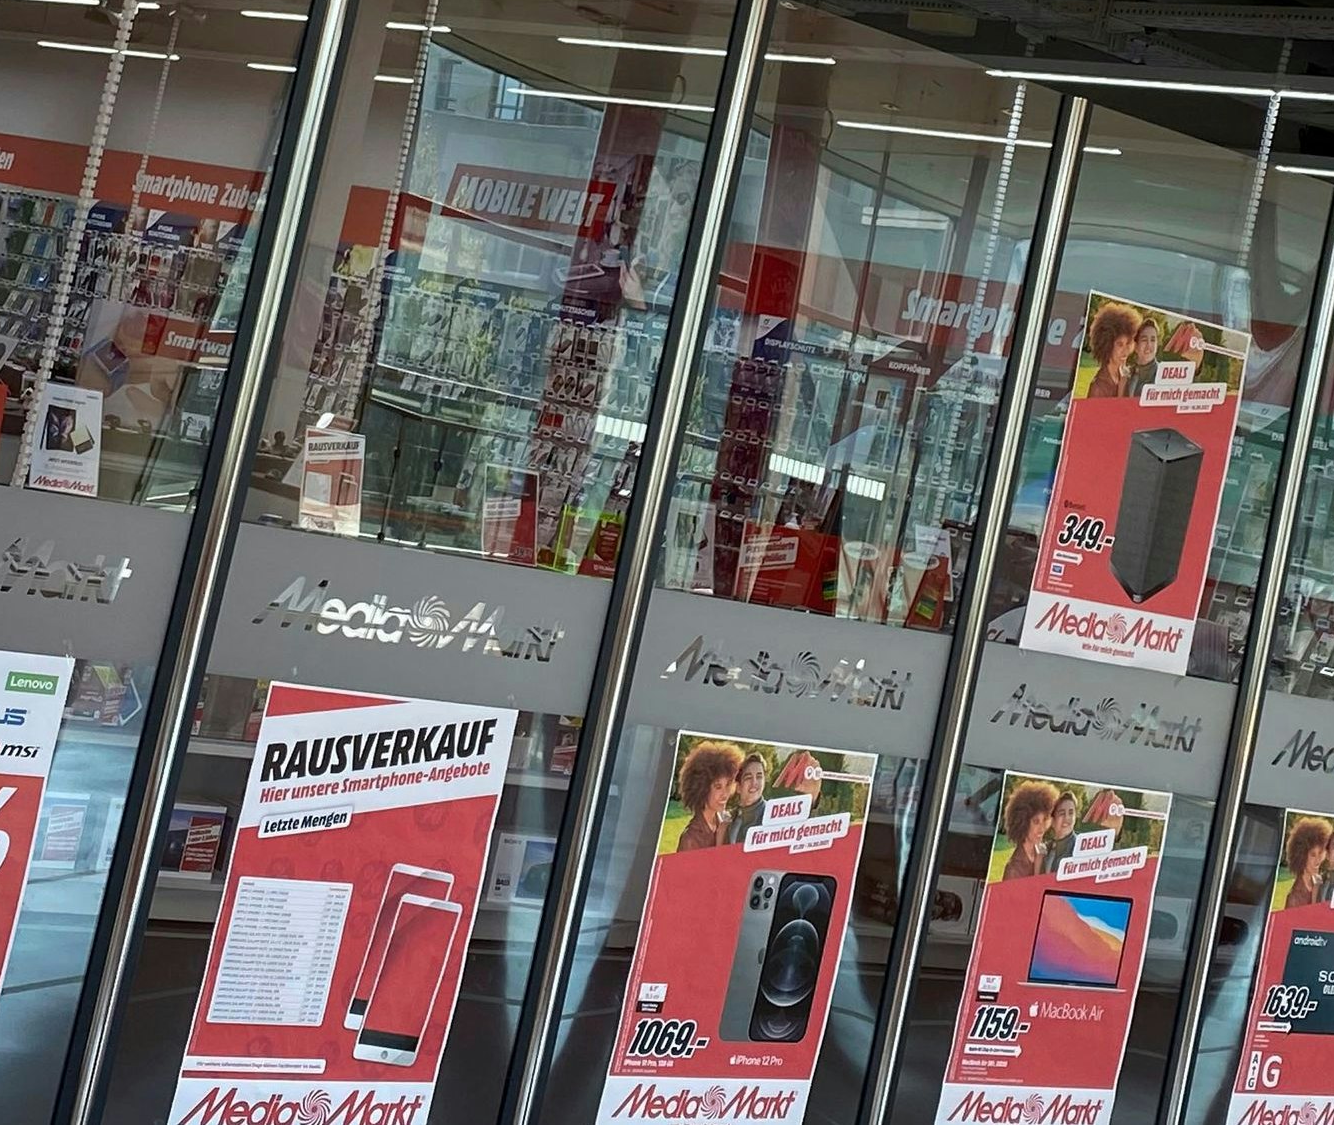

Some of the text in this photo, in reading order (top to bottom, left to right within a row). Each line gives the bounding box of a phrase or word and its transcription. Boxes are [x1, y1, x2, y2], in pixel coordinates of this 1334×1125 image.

[452, 175, 605, 229] MOBILE WELT
[764, 338, 816, 354] DISPLAYSCHUTZ
[1162, 367, 1188, 379] DEALS
[1146, 387, 1220, 402] für mich gemacht
[1058, 514, 1114, 551] 349.-
[1035, 602, 1183, 653] Media Markt
[10, 677, 54, 690] Lenovo
[0, 742, 41, 759] msi
[260, 718, 498, 782] RAUSVERKAUF
[260, 760, 491, 804] Hier unsere Smartphone-Angebote
[770, 801, 803, 820] DEALS
[264, 811, 347, 834] Letzte Mengen
[751, 828, 768, 845] für
[769, 826, 794, 842] mich
[796, 819, 843, 841] gemacht
[1080, 835, 1108, 851] DEALS
[1064, 852, 1142, 874] für mich gemacht
[969, 1005, 1031, 1041] 1159.-
[1041, 1002, 1103, 1021] MacBook Air
[628, 1018, 710, 1059] 1069.-
[736, 1055, 783, 1066] iPhone 12 Pro
[1262, 1055, 1283, 1088] G
[611, 1083, 796, 1120] Media Markt
